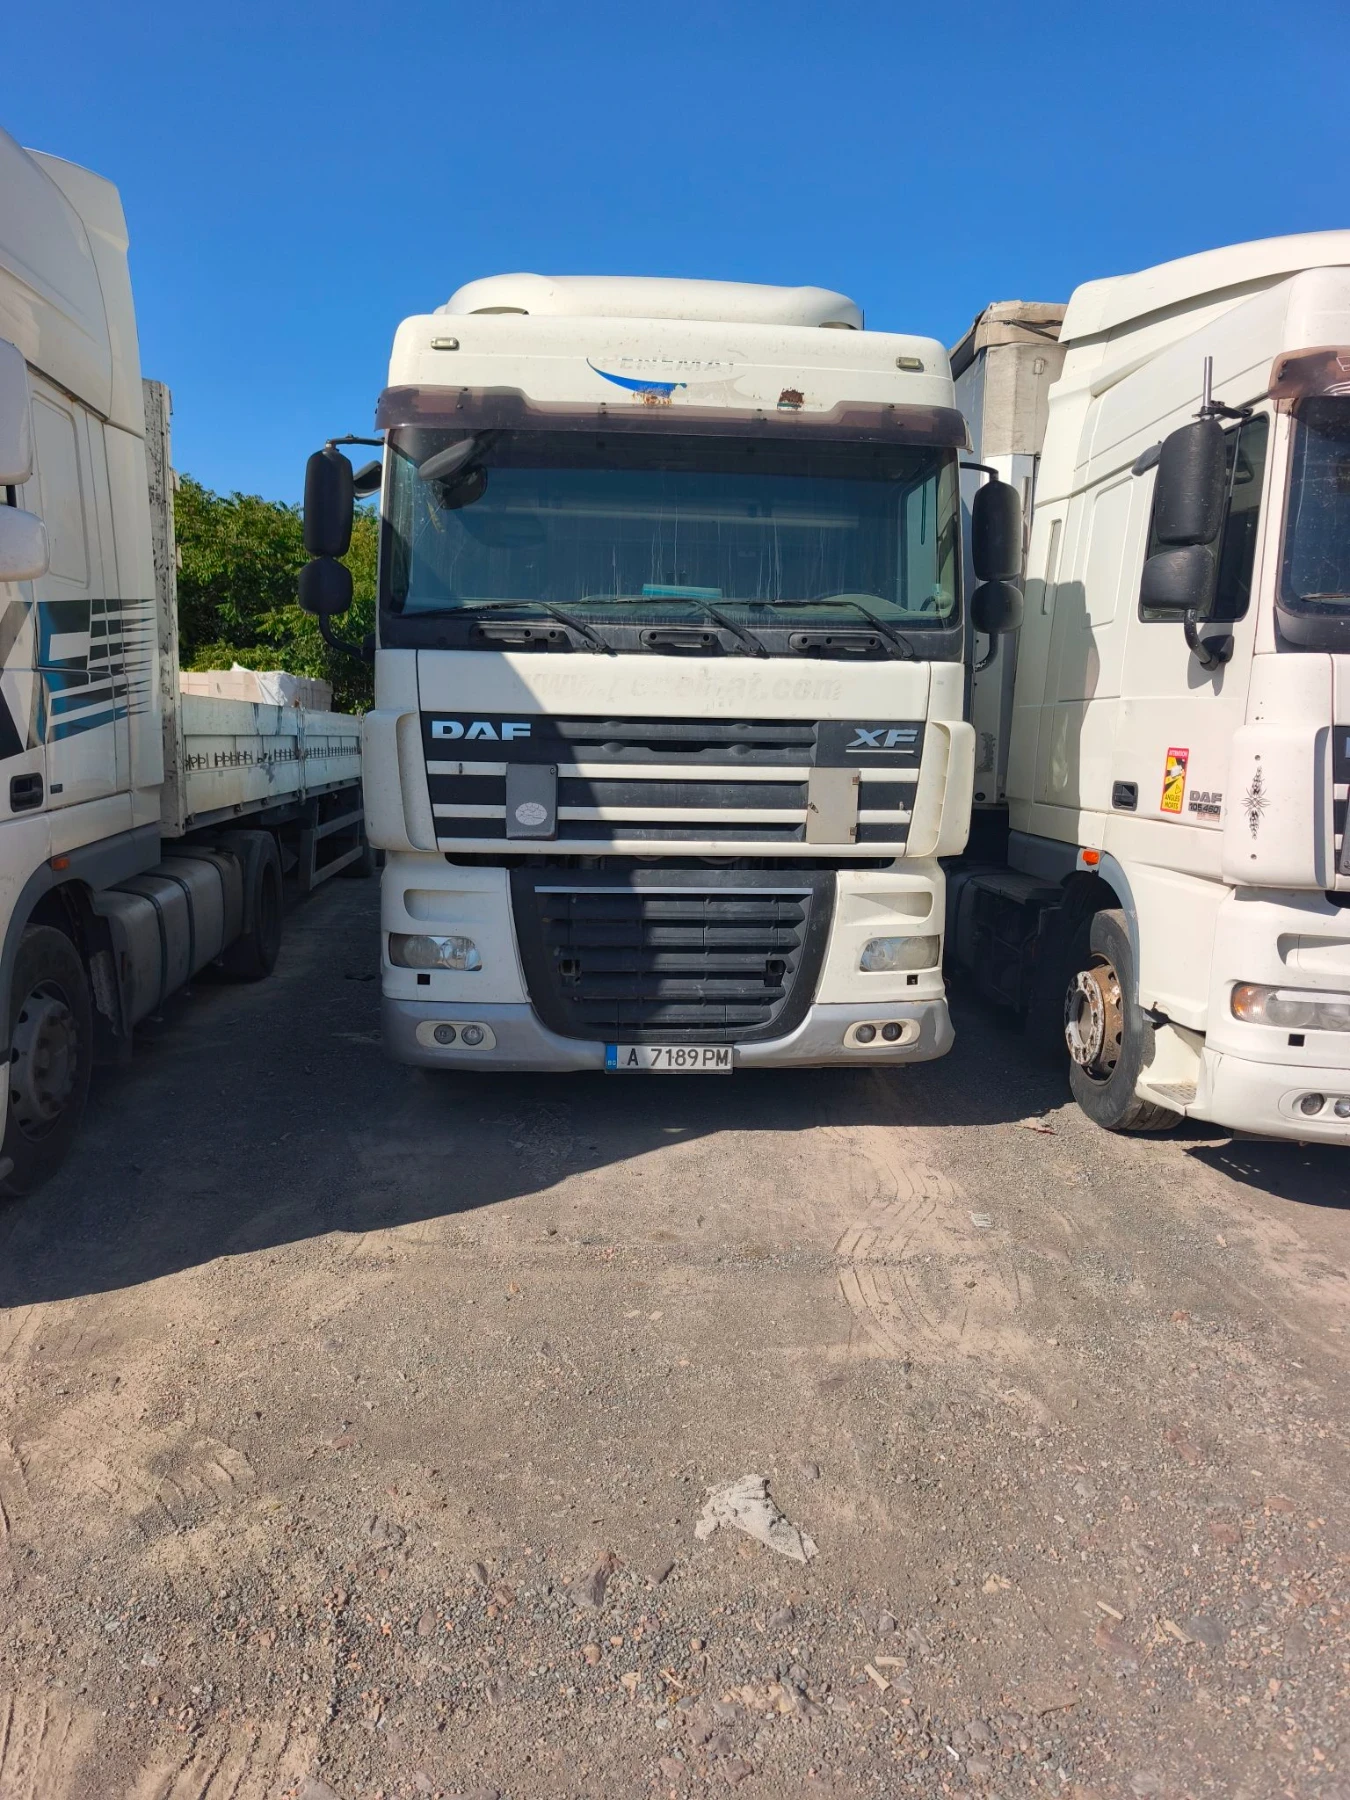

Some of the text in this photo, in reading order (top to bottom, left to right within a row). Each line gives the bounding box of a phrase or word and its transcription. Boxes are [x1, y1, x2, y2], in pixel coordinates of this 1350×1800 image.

[431, 720, 533, 742] DAF
[846, 728, 919, 749] XF
[1189, 790, 1223, 803] DAF
[626, 1048, 640, 1067] A
